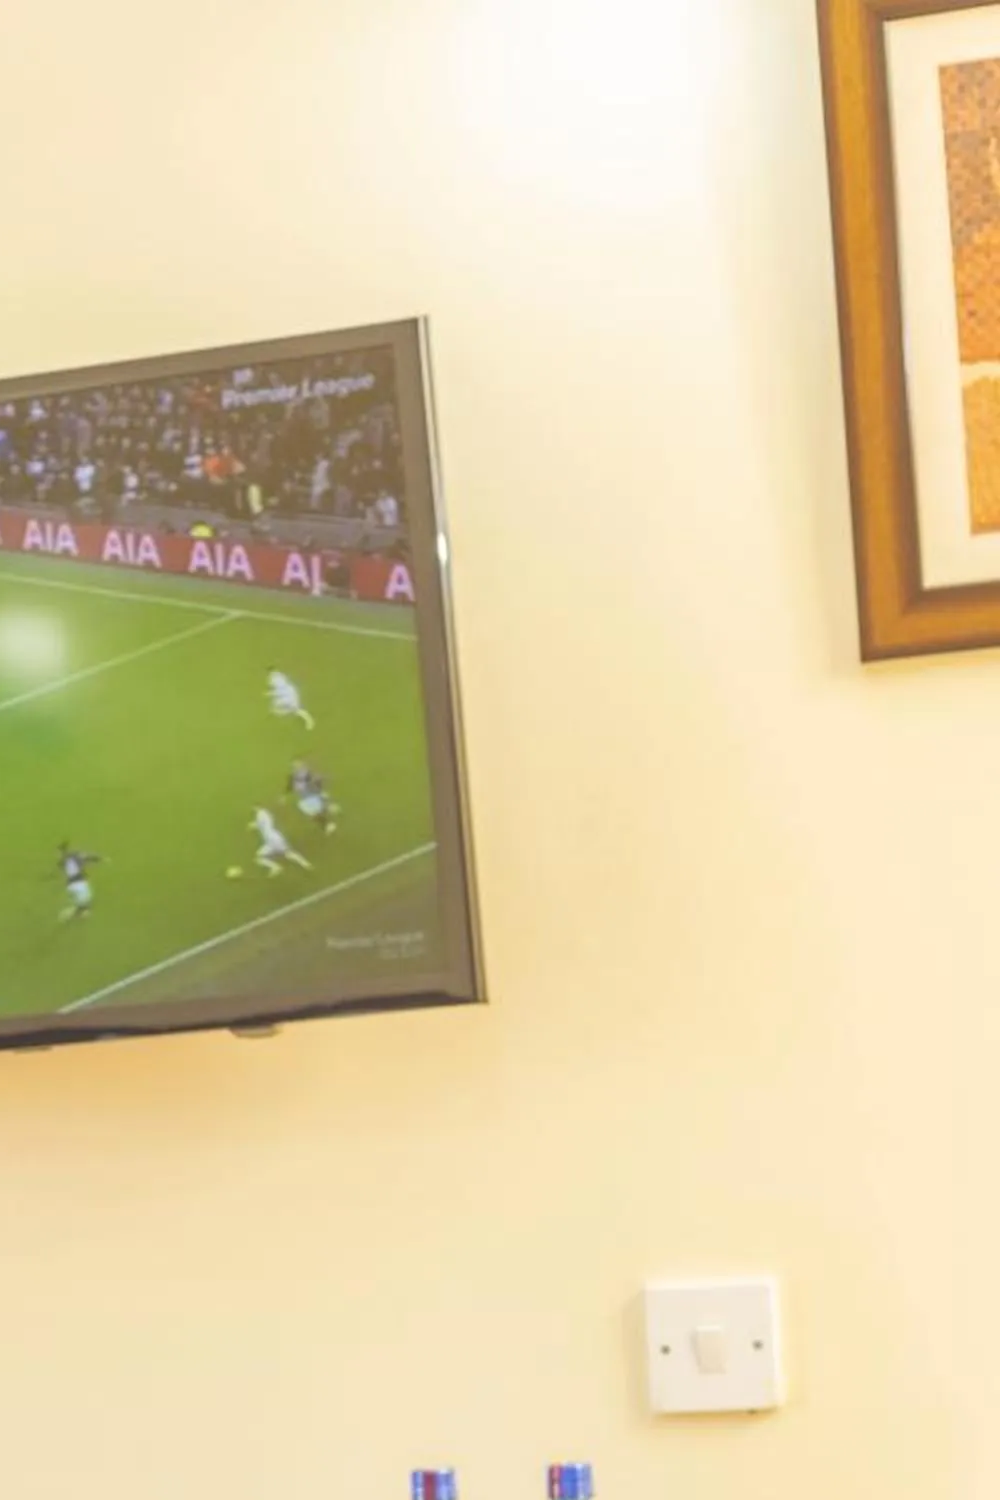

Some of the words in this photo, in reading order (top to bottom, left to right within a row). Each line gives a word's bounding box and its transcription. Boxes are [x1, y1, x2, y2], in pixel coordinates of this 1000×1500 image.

[24, 518, 80, 557] AIA
[103, 529, 163, 569] AIA
[188, 540, 255, 581] AIA
[281, 551, 325, 591] AI
